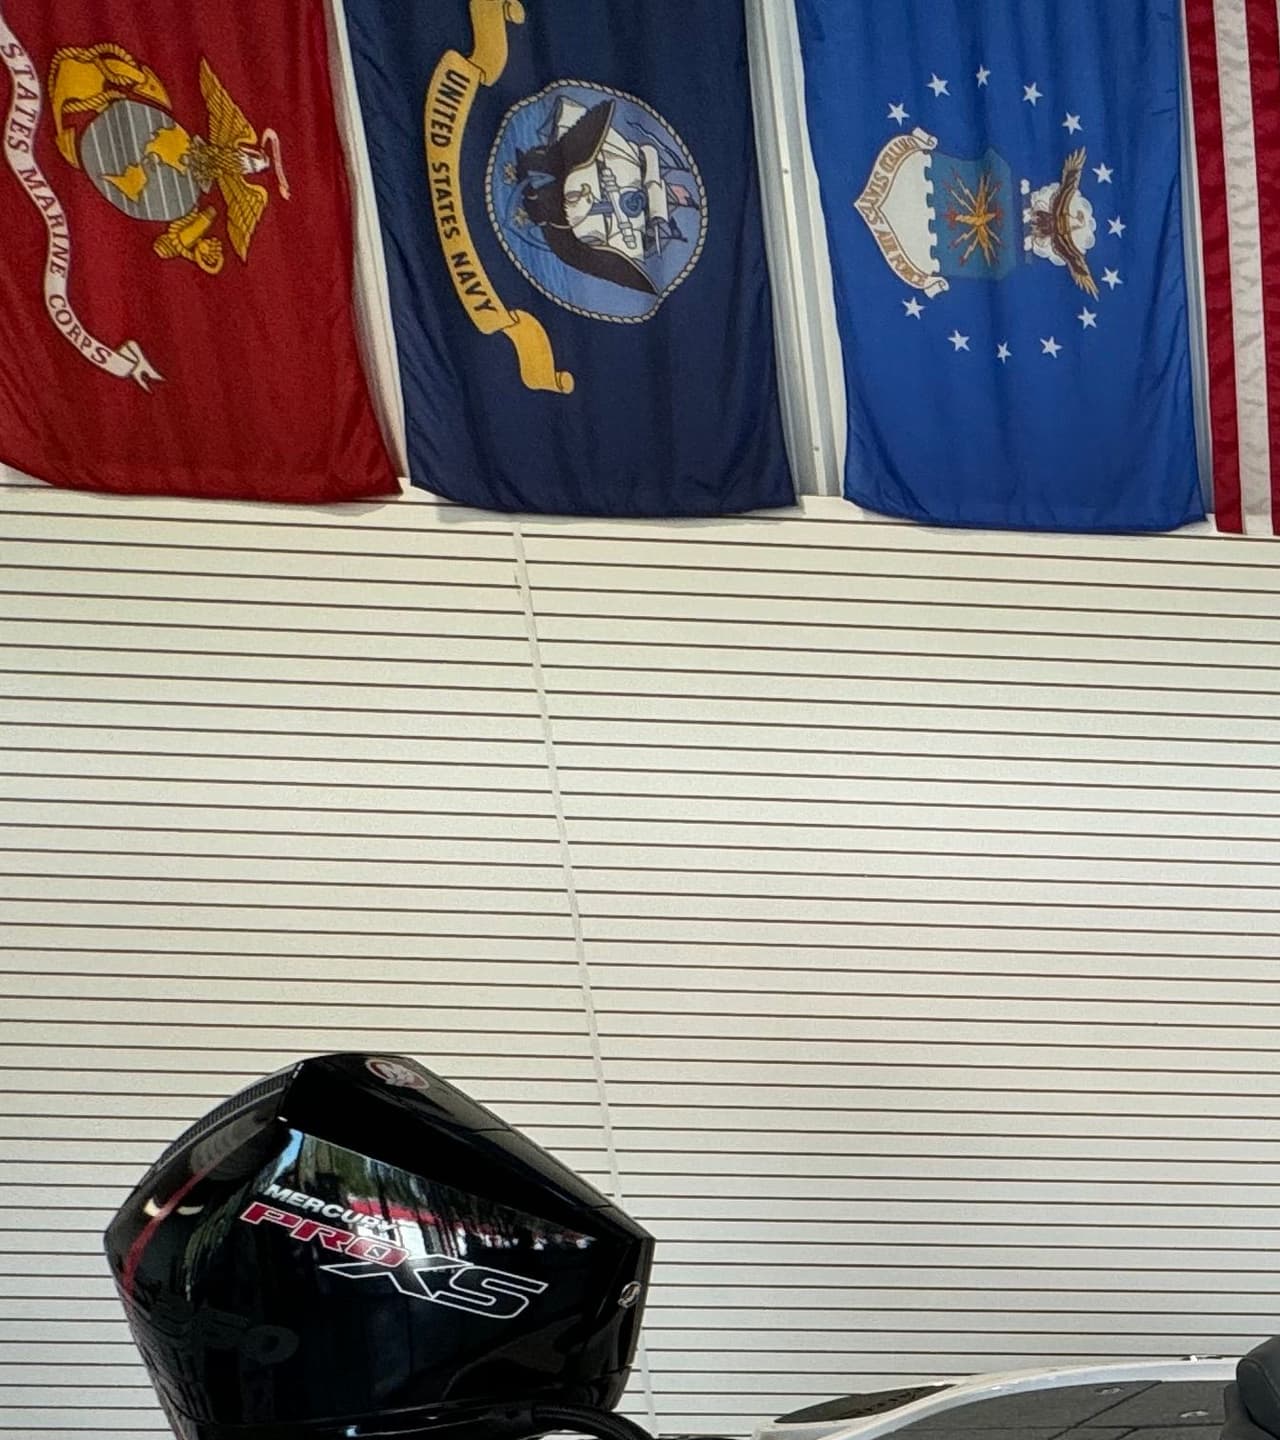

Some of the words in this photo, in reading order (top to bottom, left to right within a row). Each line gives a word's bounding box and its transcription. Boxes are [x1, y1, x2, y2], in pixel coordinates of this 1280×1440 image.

[0, 43, 40, 153] STATES
[431, 68, 471, 148] UNITED
[18, 167, 67, 278] MARINE
[431, 161, 460, 240] STATES
[451, 252, 497, 314] NAVY
[48, 293, 112, 366] CORPS
[240, 1202, 409, 1267] PRO
[264, 1184, 398, 1233] MERCURY
[319, 1254, 548, 1318] XS
